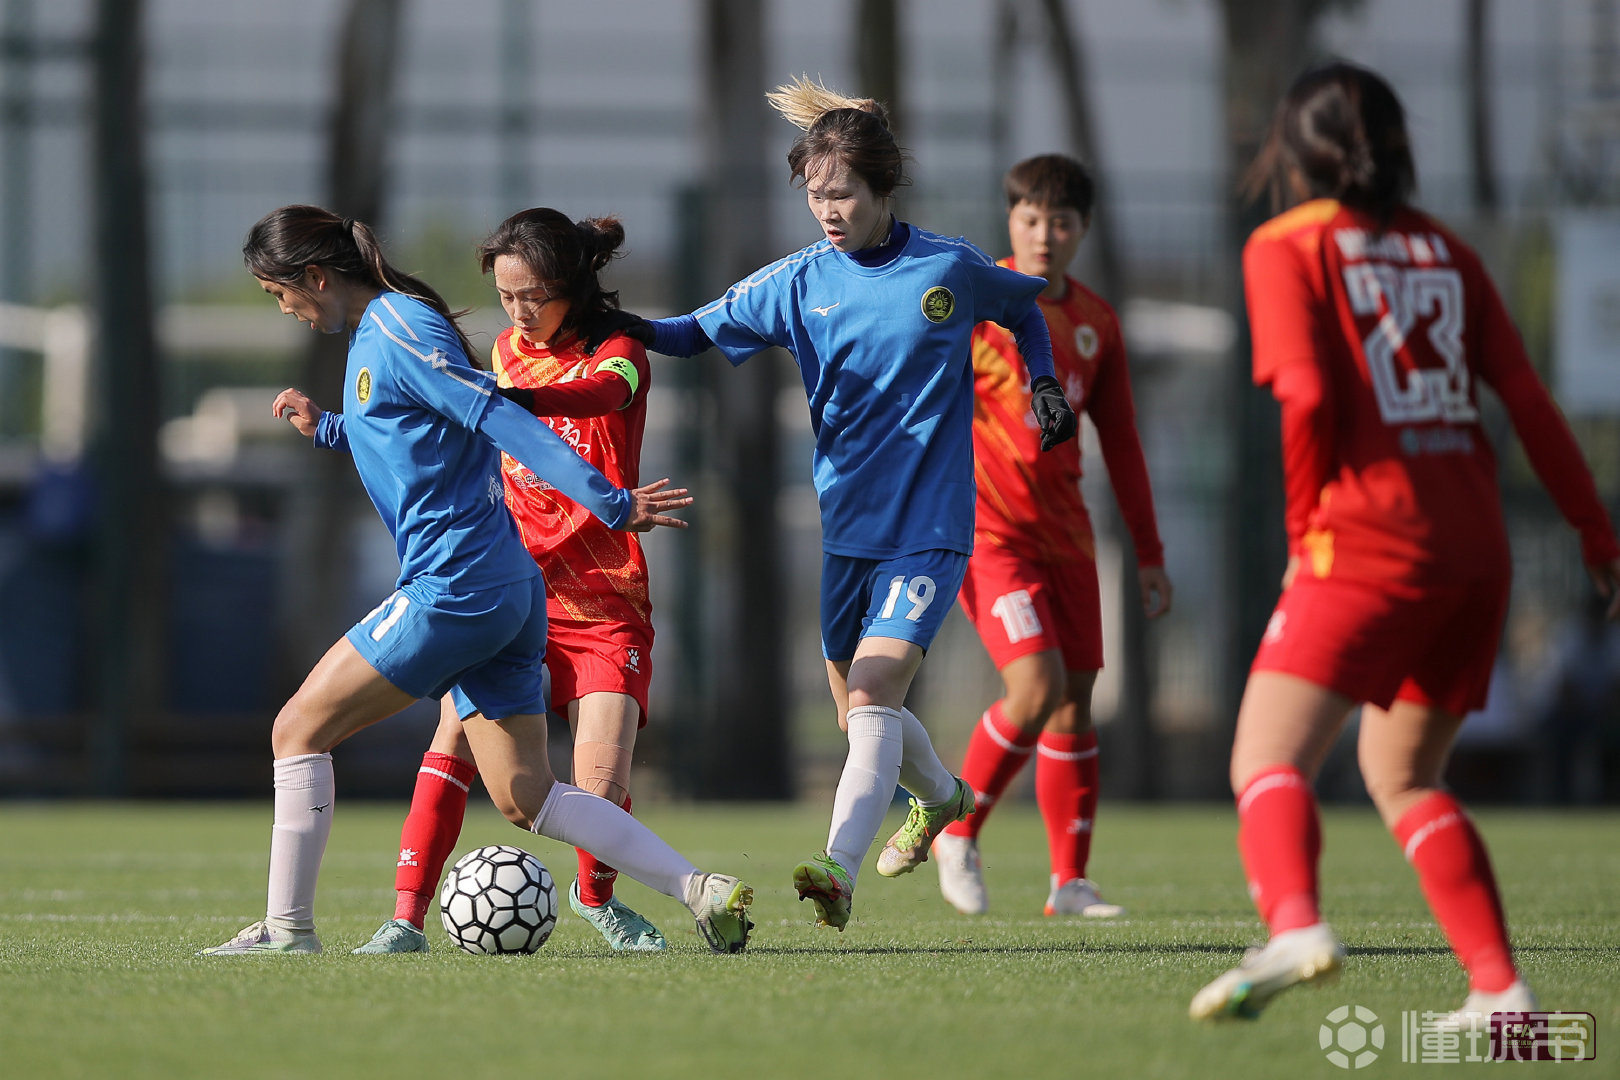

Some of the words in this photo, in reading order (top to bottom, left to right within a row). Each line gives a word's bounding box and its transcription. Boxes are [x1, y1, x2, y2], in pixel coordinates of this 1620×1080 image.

[1343, 265, 1478, 425] 23
[881, 575, 937, 621] 19
[991, 589, 1043, 643] 16
